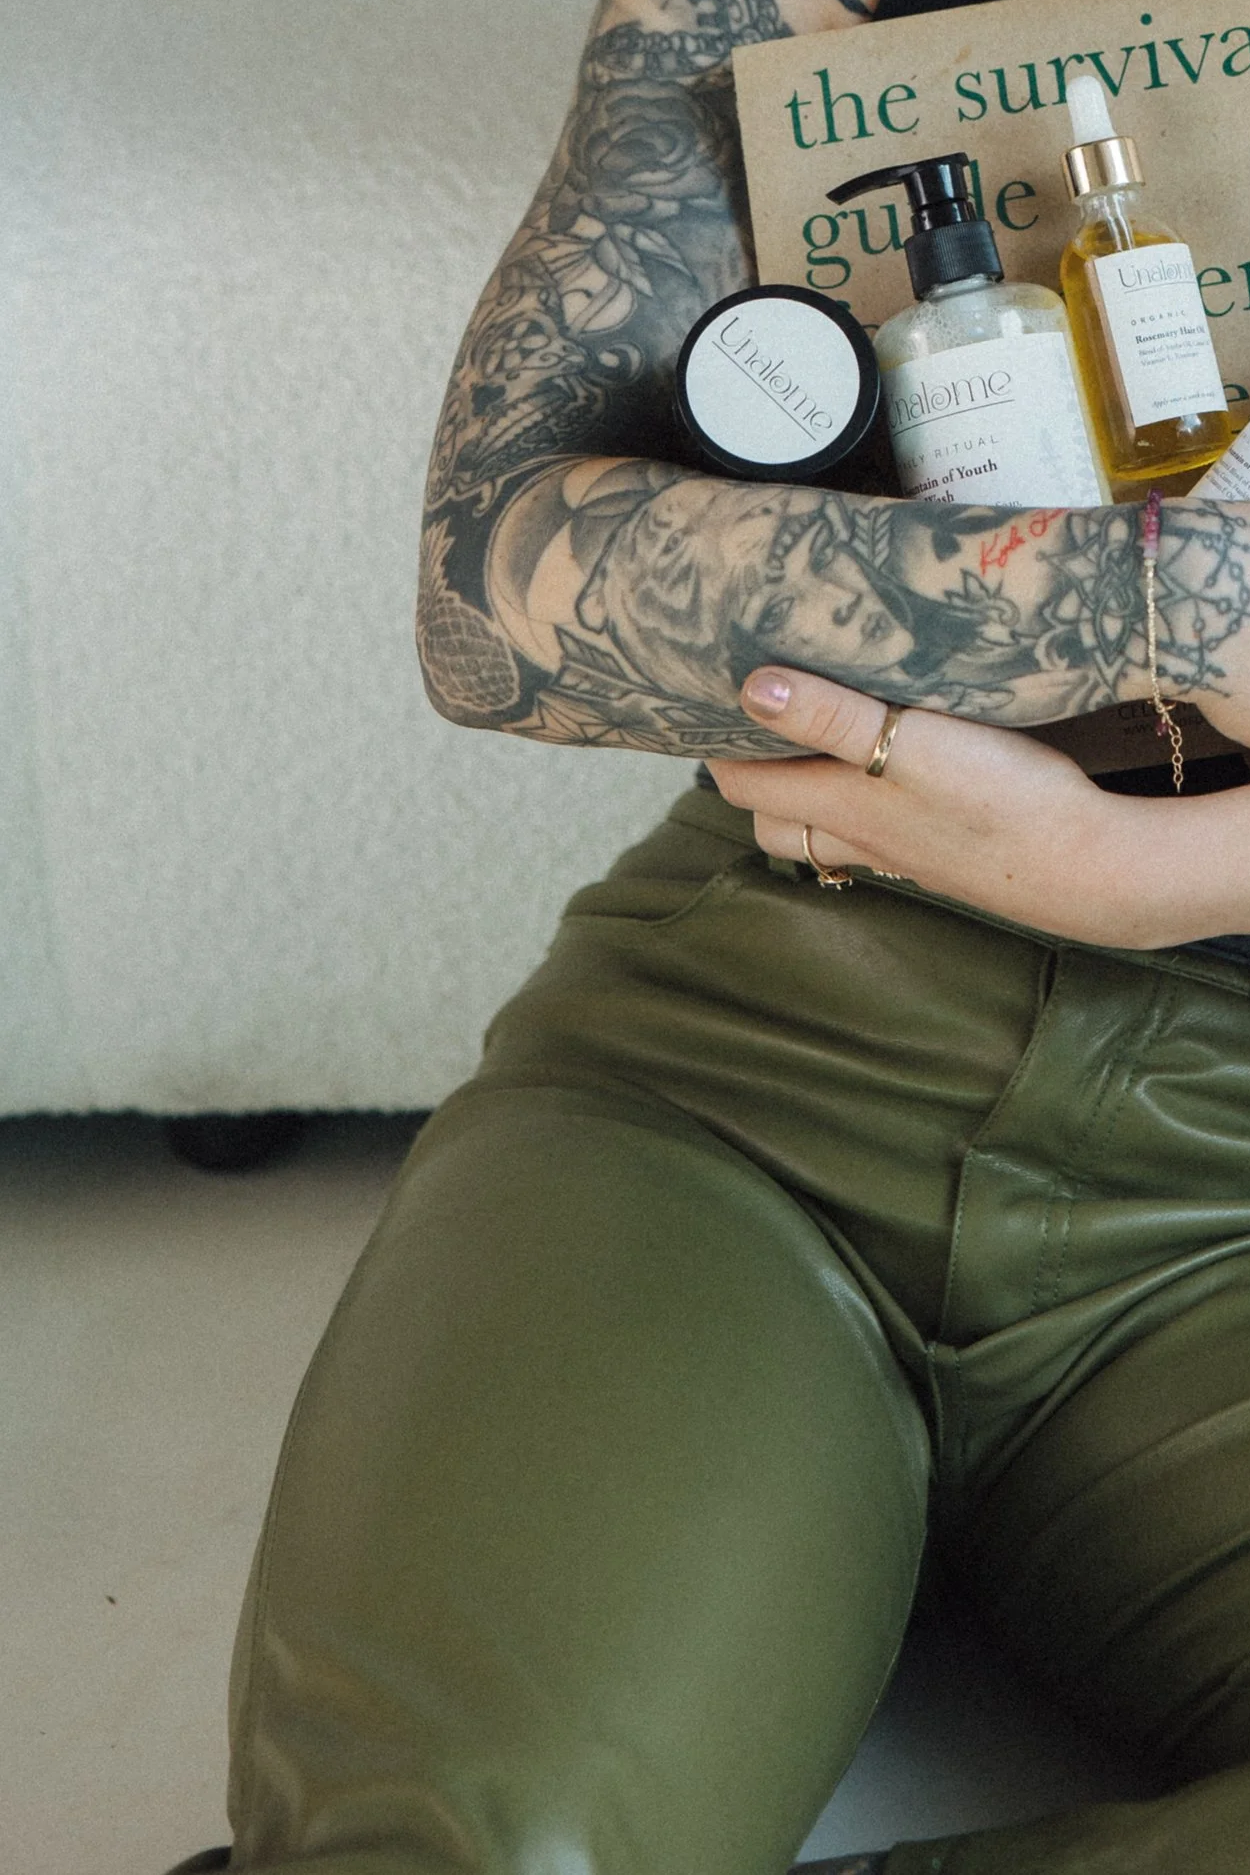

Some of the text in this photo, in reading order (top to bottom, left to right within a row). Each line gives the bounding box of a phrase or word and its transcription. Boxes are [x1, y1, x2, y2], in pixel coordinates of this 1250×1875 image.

[784, 68, 920, 149] the
[802, 159, 1040, 290] gude
[1135, 328, 1178, 345] Rosemary
[719, 316, 833, 432] Unalome
[934, 434, 1000, 460] RITUAL
[941, 469, 956, 485] of
[956, 458, 999, 480] Youth
